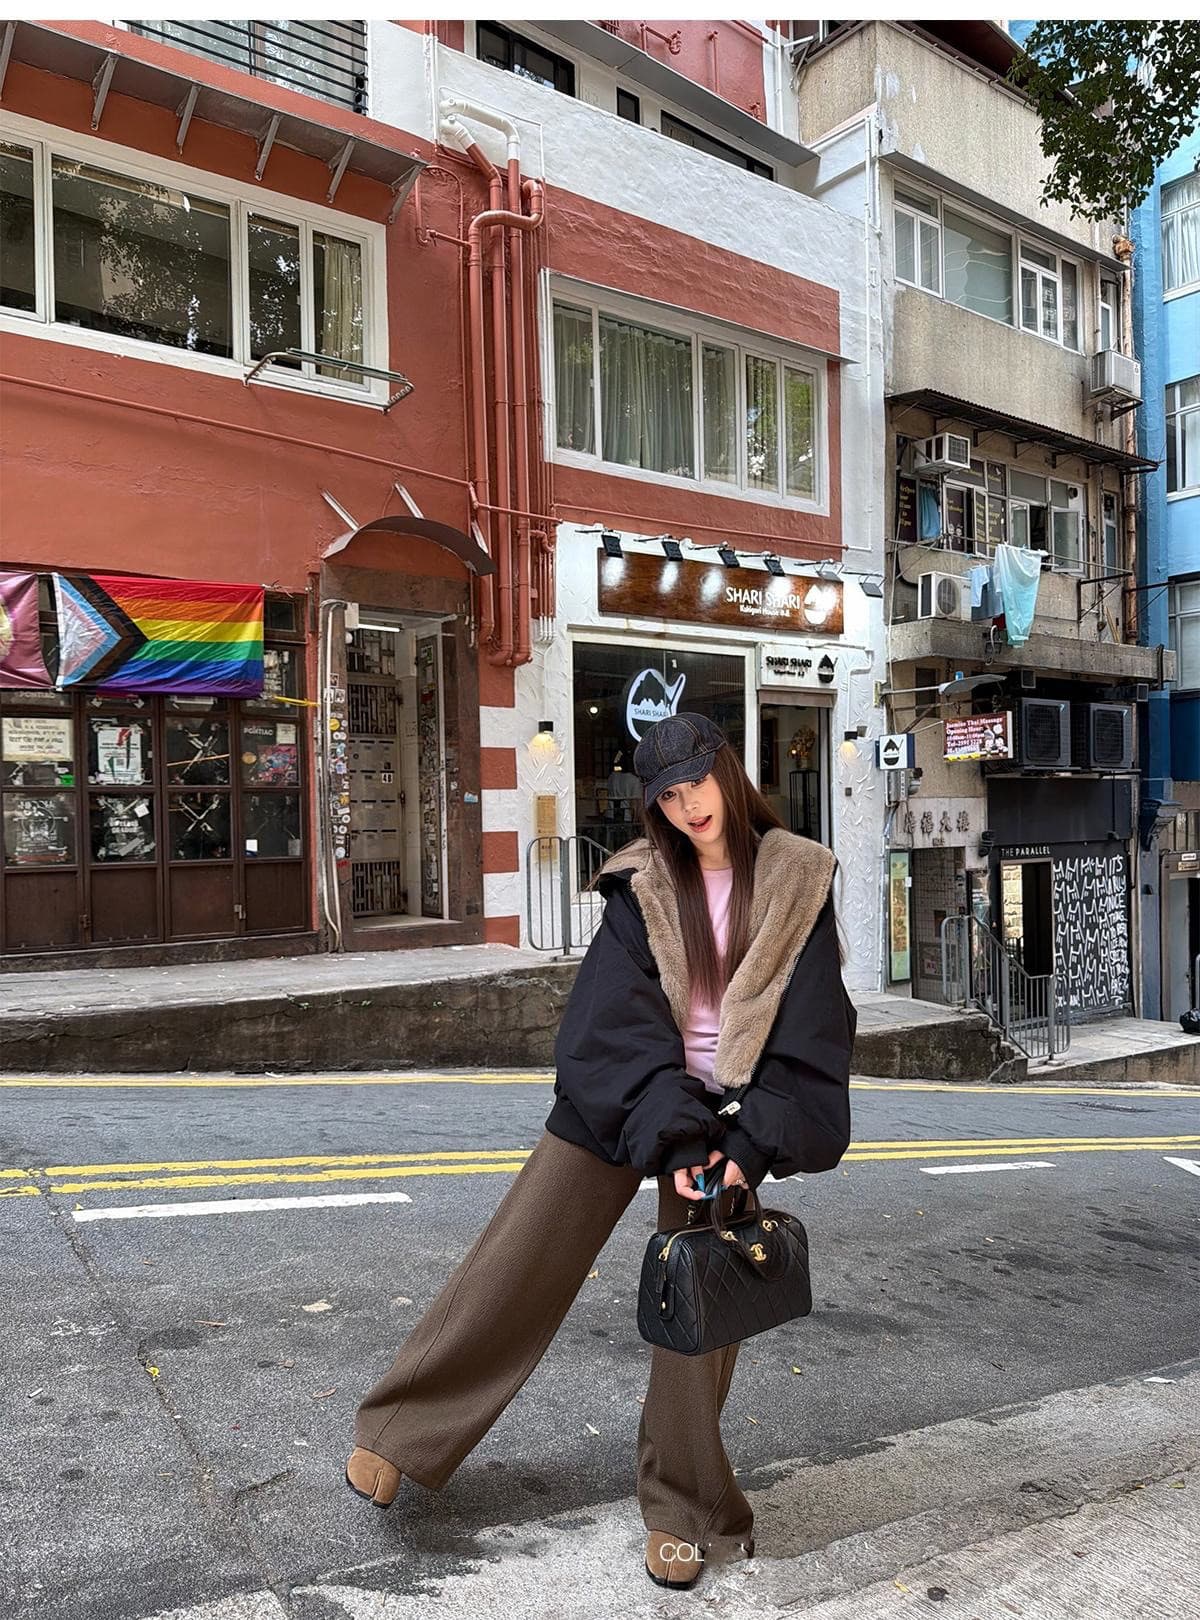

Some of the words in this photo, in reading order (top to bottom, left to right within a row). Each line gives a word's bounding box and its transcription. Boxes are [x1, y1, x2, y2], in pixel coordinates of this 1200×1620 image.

[726, 587, 762, 605] SHARI
[766, 591, 800, 610] SHARI
[634, 708, 651, 716] SHARI
[1001, 848, 1014, 856] THE
[1015, 846, 1051, 855] PARALLEL
